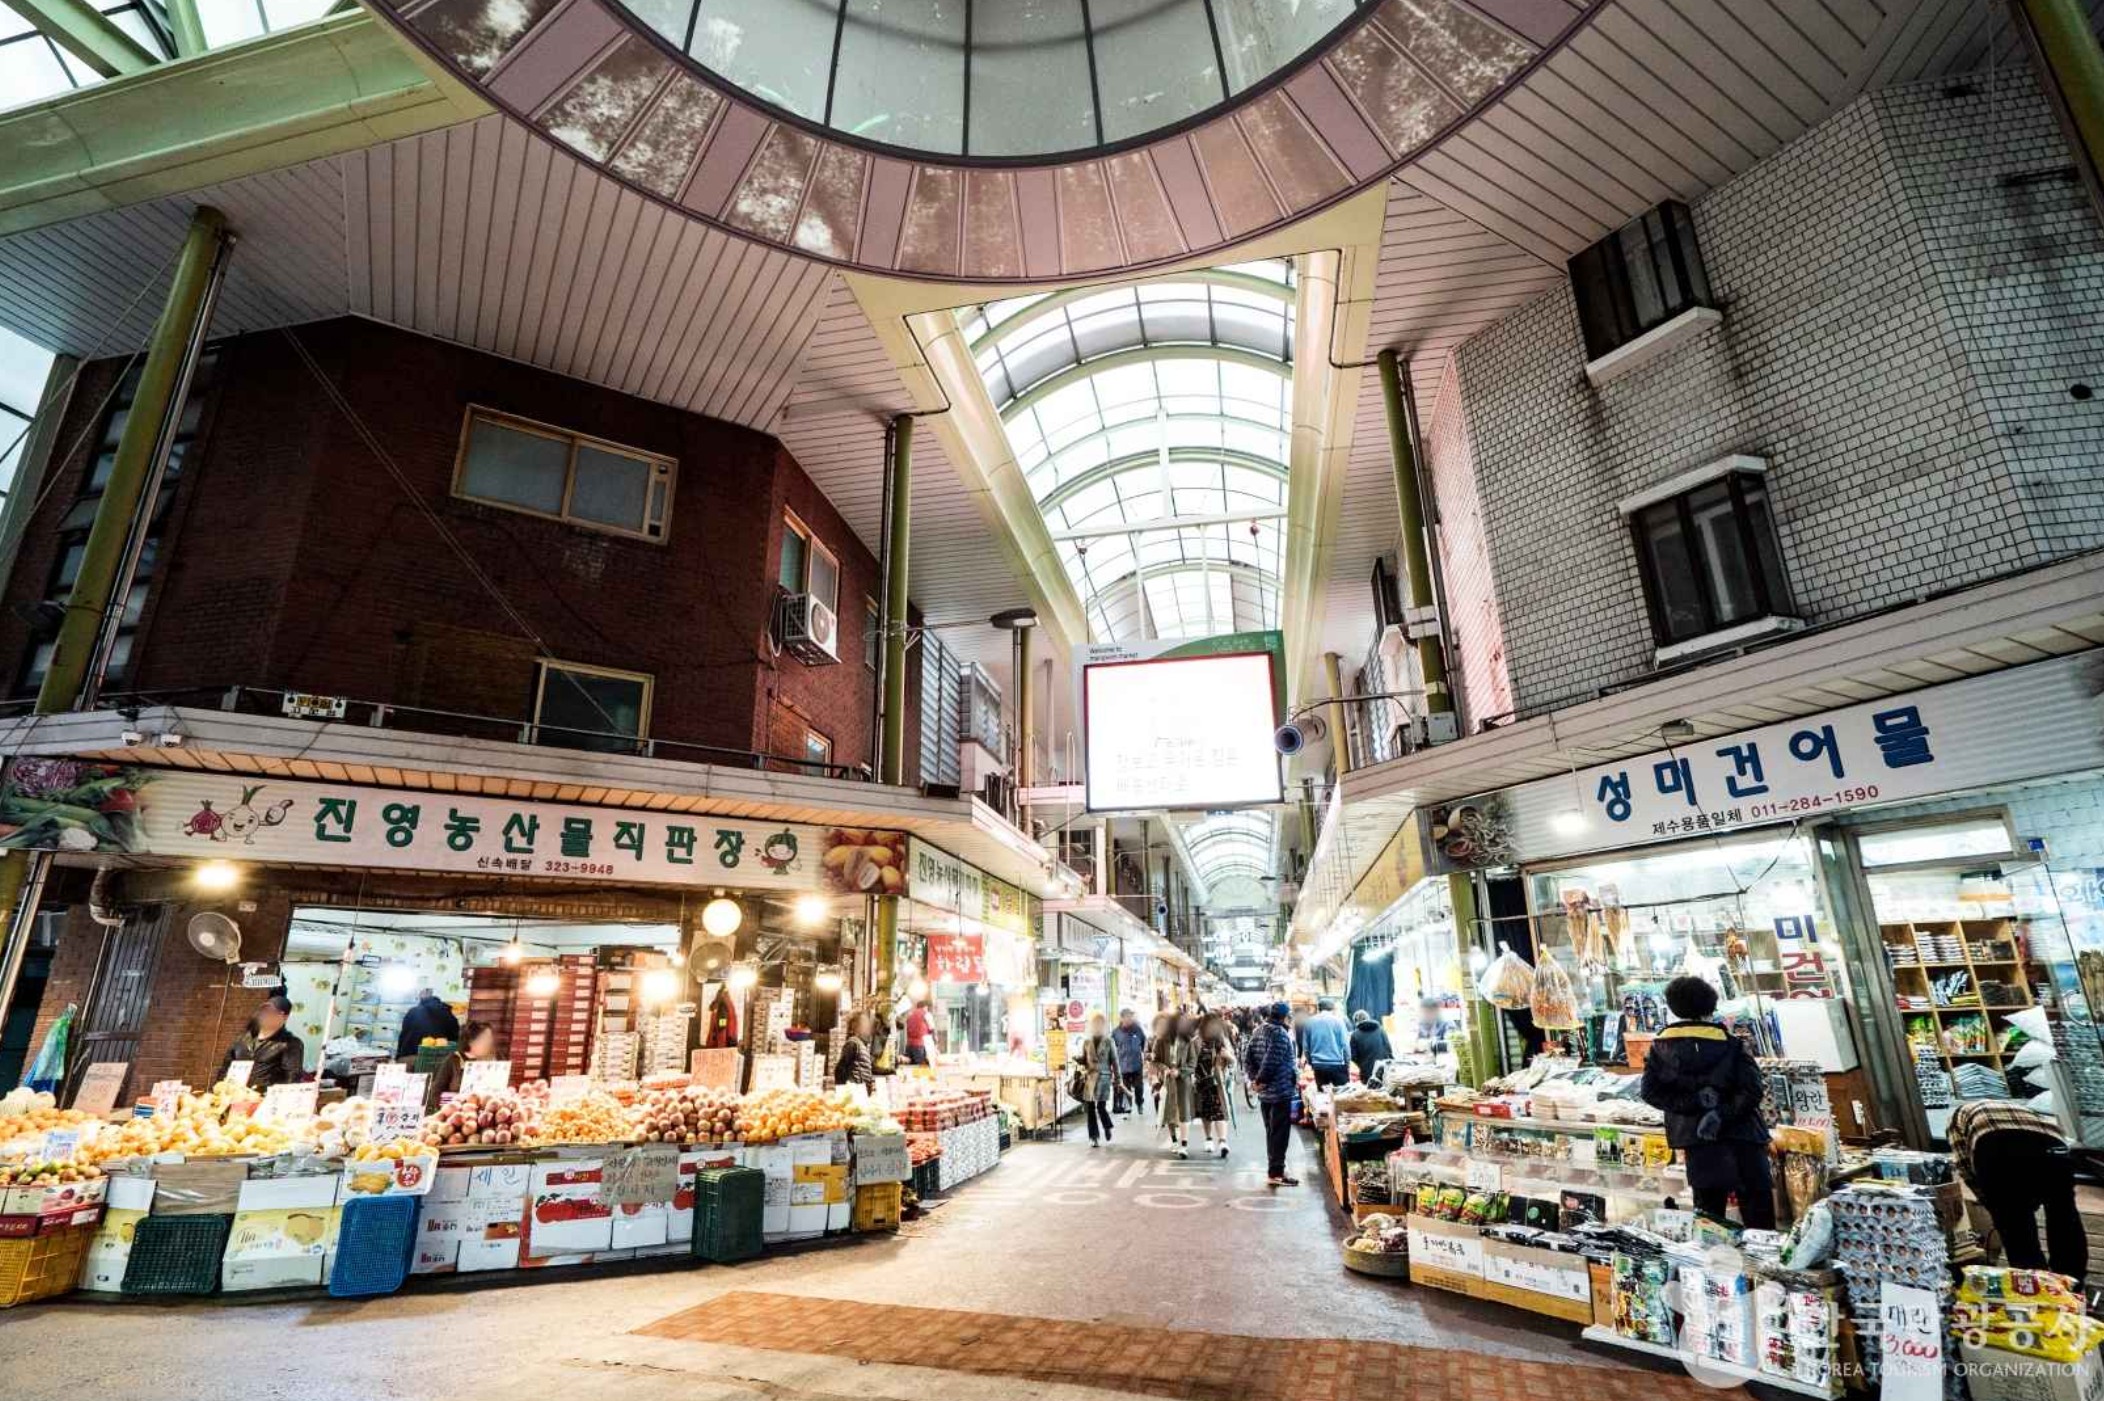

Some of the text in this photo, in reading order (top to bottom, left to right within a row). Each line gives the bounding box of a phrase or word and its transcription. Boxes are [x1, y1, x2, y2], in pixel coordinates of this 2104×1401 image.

[1597, 705, 1935, 822] 성미건어물
[314, 797, 745, 869] 진영농산물직판장
[1652, 784, 1879, 836] 제수용품일체 011-284-1590
[477, 856, 613, 875] 신속배달 323-9948
[1888, 1304, 1934, 1335] 대란
